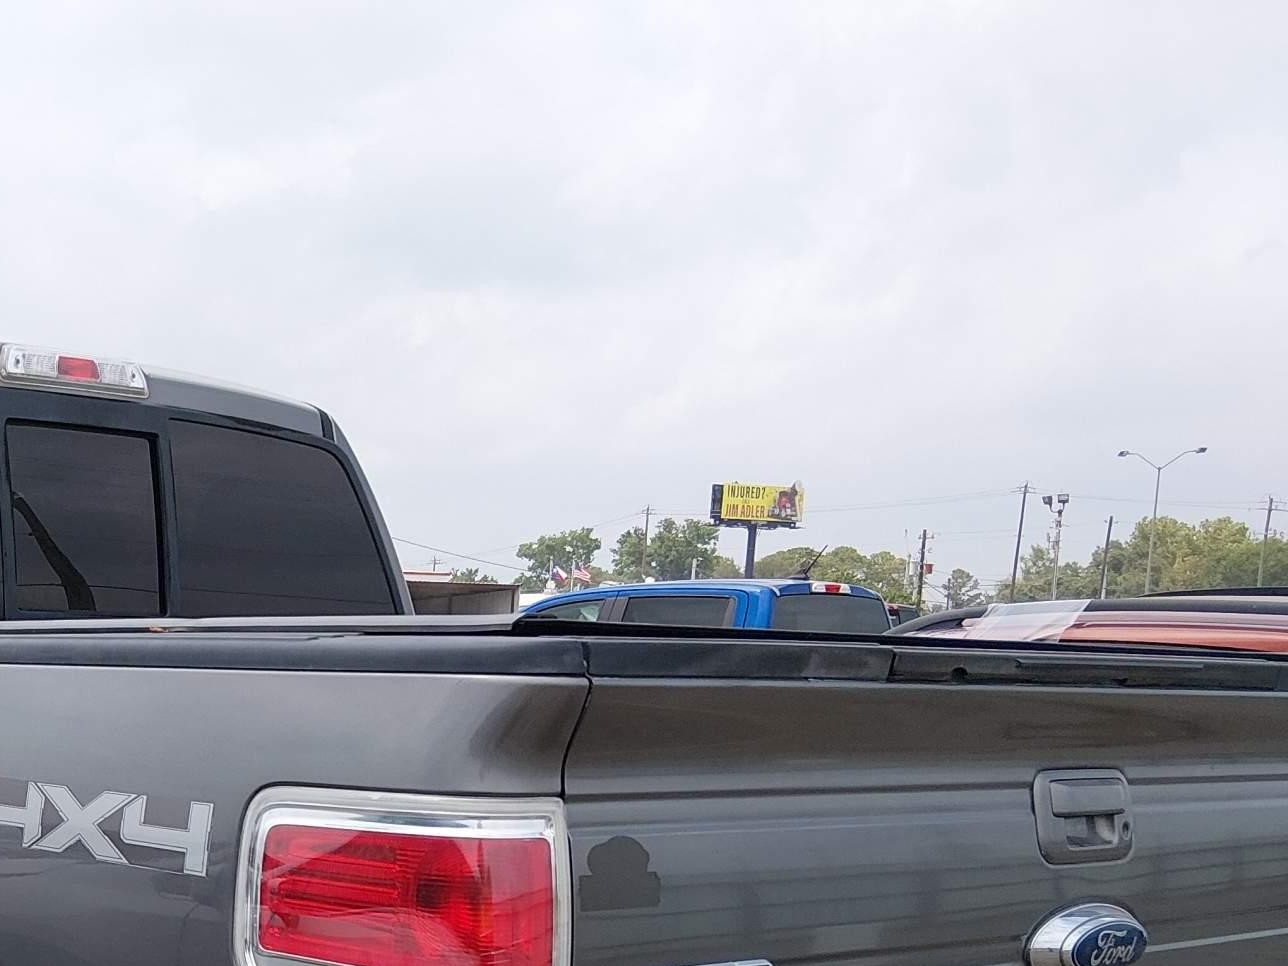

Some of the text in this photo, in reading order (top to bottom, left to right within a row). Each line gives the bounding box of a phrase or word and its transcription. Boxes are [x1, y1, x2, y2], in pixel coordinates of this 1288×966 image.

[727, 485, 766, 500] INJURED?
[724, 503, 766, 519] JIM ADLER
[1090, 929, 1138, 966] Ford
